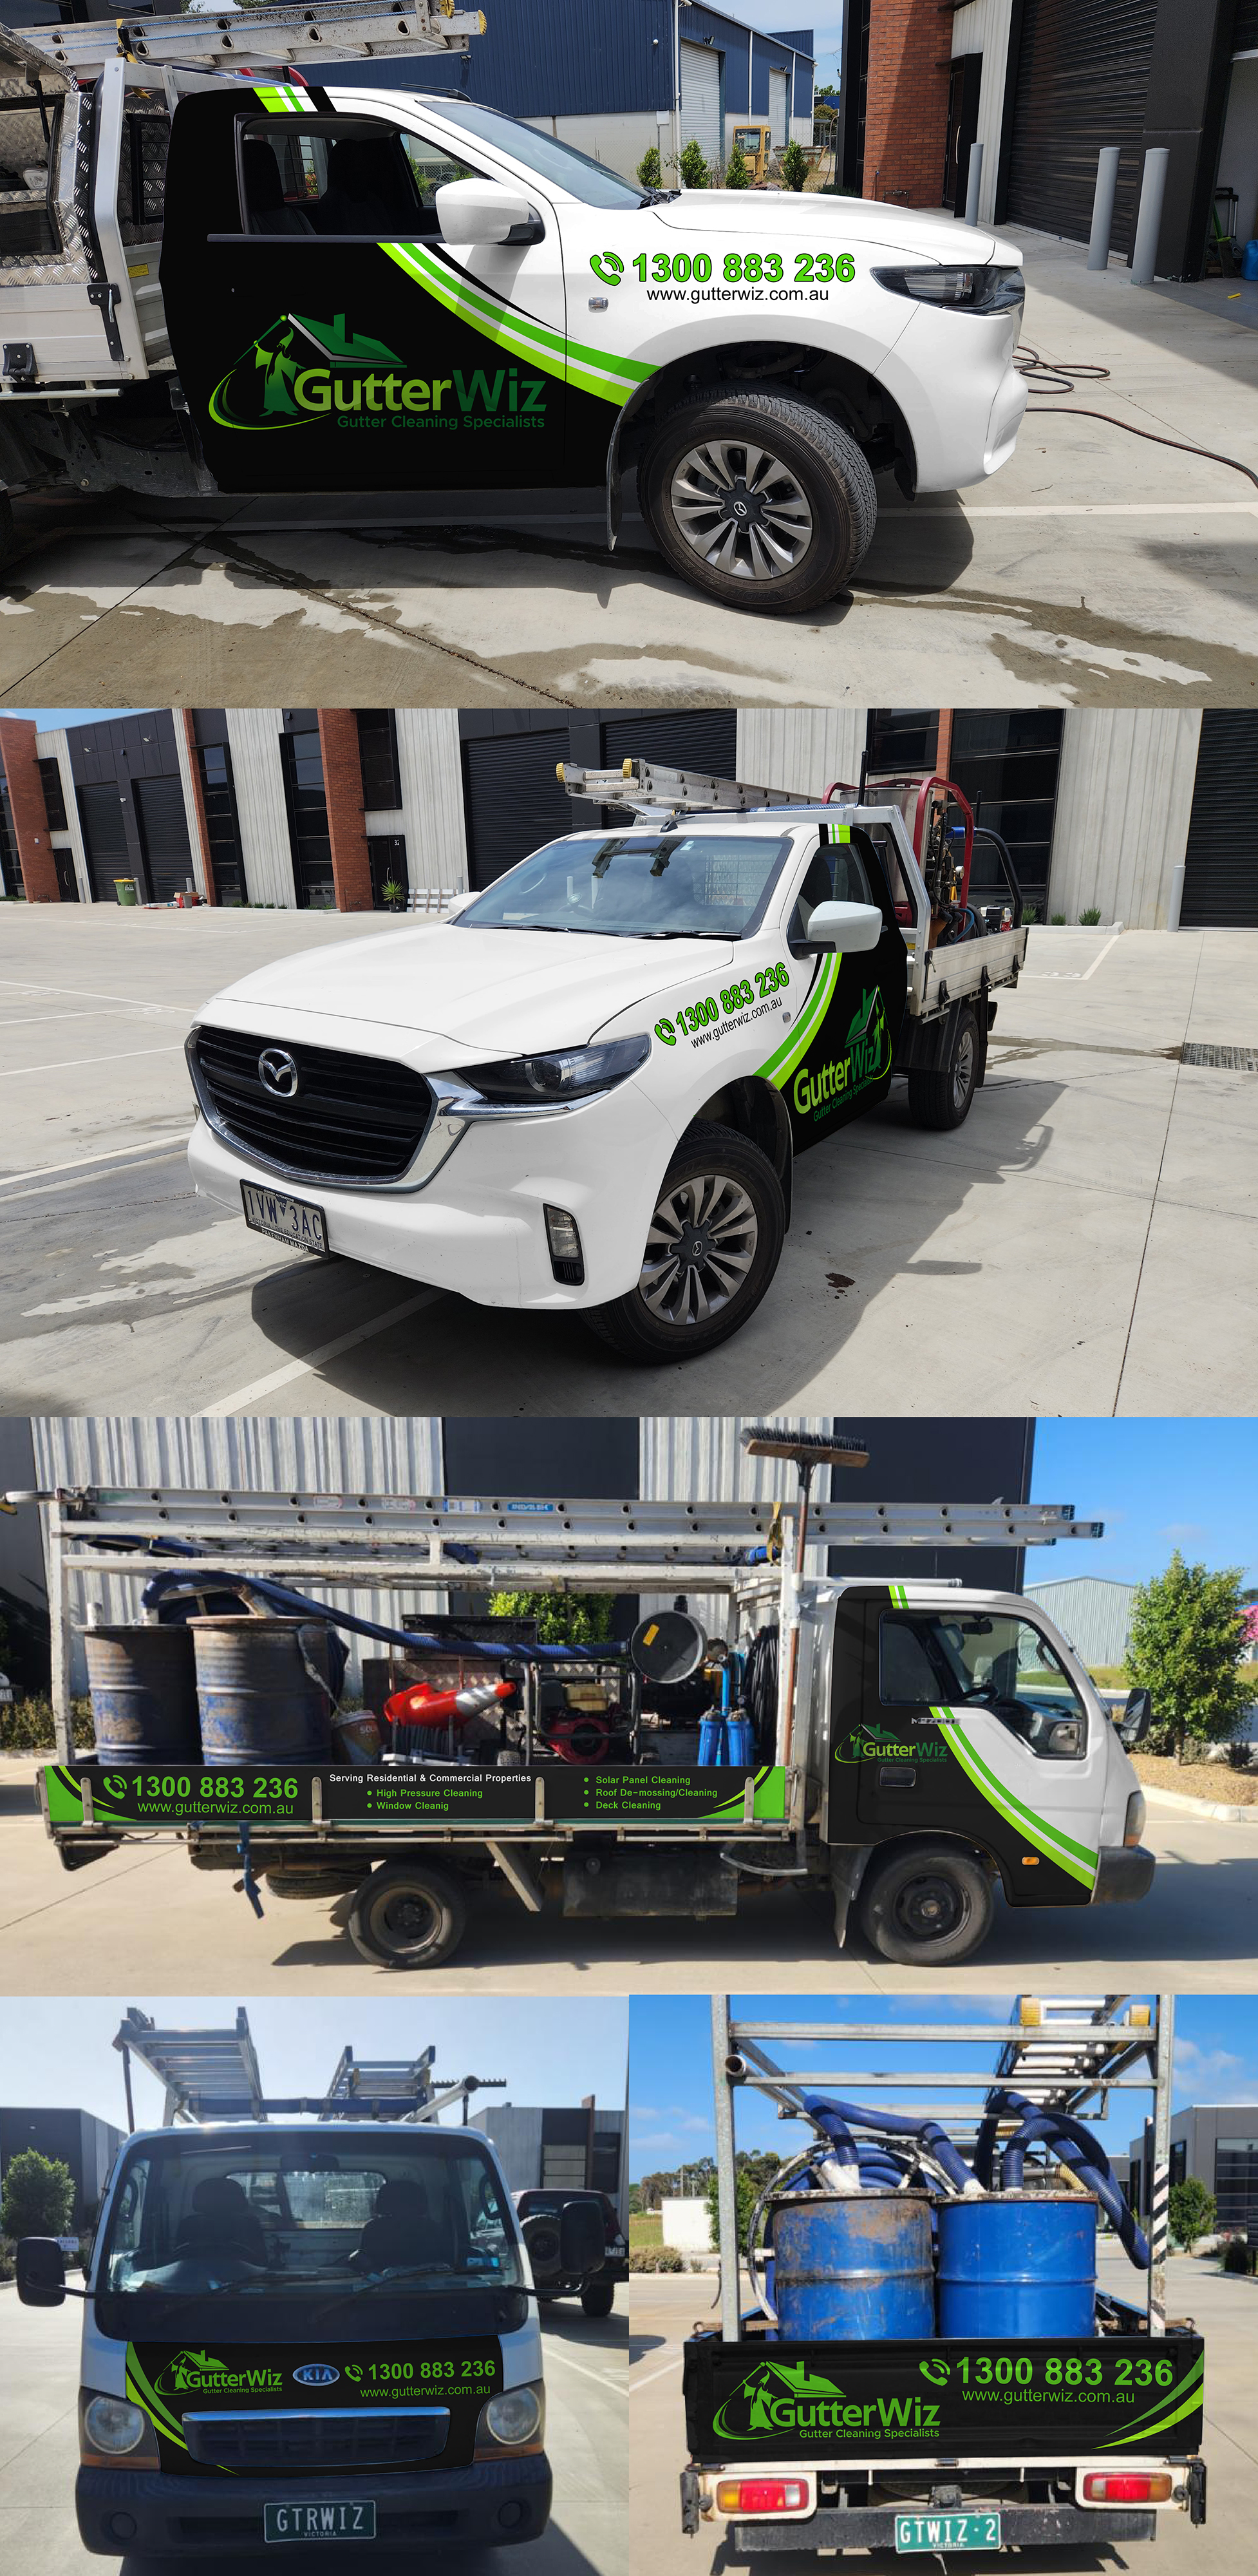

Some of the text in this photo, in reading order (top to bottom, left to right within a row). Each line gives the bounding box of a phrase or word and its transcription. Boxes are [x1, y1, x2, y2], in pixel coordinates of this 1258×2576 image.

[632, 253, 856, 283] 1300 883 236
[646, 287, 829, 304] www.gutterwiz.com.au
[294, 368, 547, 412] GutterWiz
[337, 415, 545, 430] Gutter Cleaning Specialists
[675, 962, 790, 1036] 1300 883 236
[691, 997, 783, 1048] www.gutterwiz.com.au
[793, 1037, 876, 1114] GutterWiz
[813, 1074, 874, 1122] Gutter Cleaning Specialists
[289, 1205, 322, 1241] 3AC
[261, 1228, 309, 1252] PAKENHAM MAZDA
[284, 1228, 309, 1243] EDUCATION
[309, 1238, 323, 1249] STATE
[863, 1741, 948, 1757] GutterWiz
[132, 1776, 298, 1799] 1300 883 236
[329, 1774, 363, 1784] Serving
[366, 1774, 417, 1782] Residential
[429, 1774, 482, 1782] Commercial
[485, 1774, 532, 1784] Properties
[596, 1776, 691, 1786] Solar Panel Cleaning
[377, 1789, 397, 1799] High
[443, 1788, 483, 1799] Cleaning
[620, 1788, 718, 1798] De-mossing/Cleaning
[137, 1801, 294, 1816] www.gutterwiz.com.au
[415, 1802, 449, 1811] Cleanig
[622, 1801, 661, 1811] Cleaning
[186, 2369, 283, 2388] GutterWiz
[303, 2369, 333, 2381] KIA
[368, 2360, 496, 2380] 1300 883 236
[956, 2356, 1173, 2387] 1300 883 236
[360, 2385, 491, 2400] www.gutterwiz.com.au
[962, 2389, 1135, 2405] www.gutterwiz.com.au
[770, 2396, 941, 2427] GutterWiz
[799, 2429, 940, 2439] Gutter Cleaning Specialists
[277, 2506, 364, 2532] GTRWIZ
